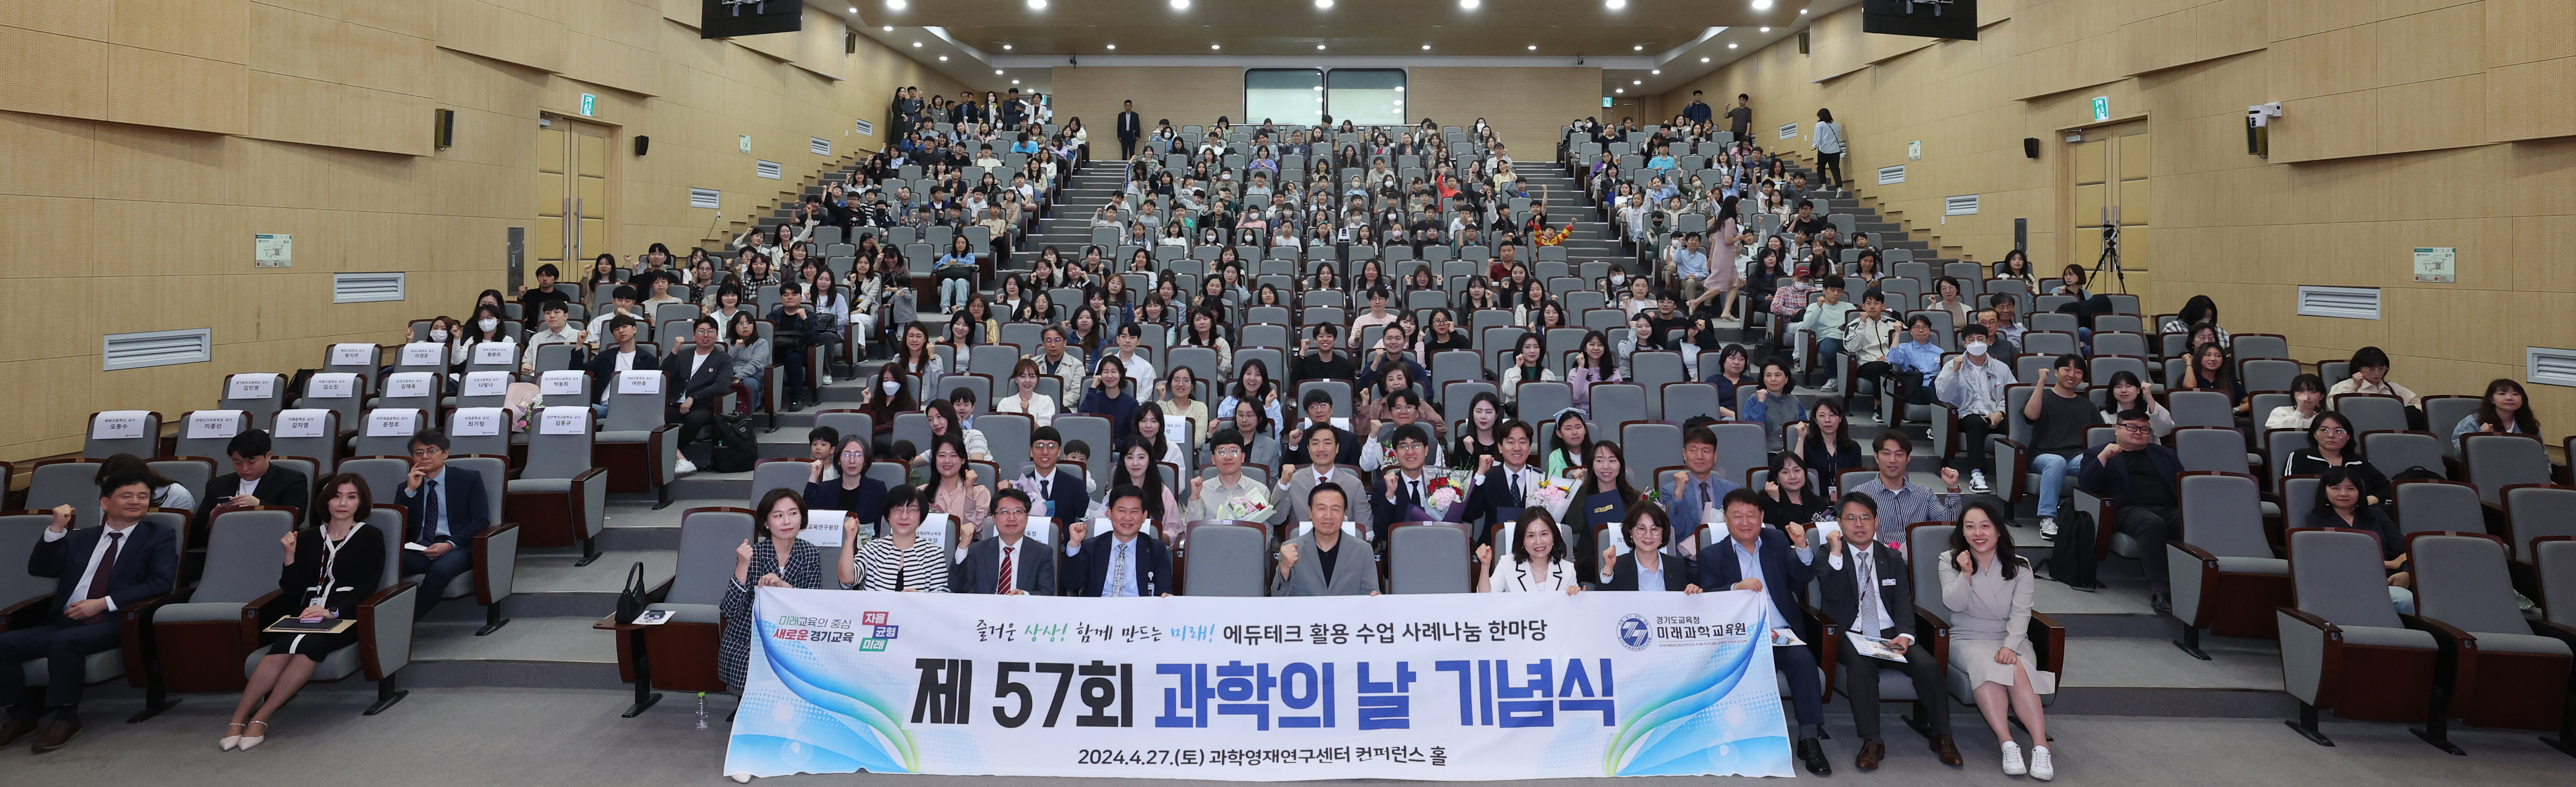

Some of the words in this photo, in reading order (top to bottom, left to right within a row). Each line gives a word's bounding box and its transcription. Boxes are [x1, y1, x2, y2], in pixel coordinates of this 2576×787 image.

[779, 616, 827, 627] 미래교육의
[831, 620, 851, 629] 중심
[865, 612, 886, 624] 자율
[773, 628, 808, 640] 새로운
[811, 631, 854, 642] 경기교육
[875, 626, 896, 637] 균형
[977, 620, 1016, 641] 즐거운
[1025, 623, 1067, 642] 상상!
[1076, 622, 1113, 643] 함께
[1122, 625, 1162, 643] 만드는
[1171, 624, 1215, 642] 미래!
[1224, 625, 1303, 645] 에듀테크
[1310, 623, 1349, 644] 활용
[1356, 622, 1394, 644] 수업
[1402, 622, 1482, 642] 사례나눔
[1488, 619, 1547, 641] 한마당
[1657, 622, 1746, 639] 미래과학교육원
[862, 640, 886, 650] 미래
[911, 658, 972, 724] 제
[993, 660, 1133, 728] 57회
[1155, 661, 1335, 731] 과학의
[1357, 662, 1416, 730] 날
[1436, 658, 1615, 728] 기념식
[1078, 749, 1204, 766] 2024.4.27.(토)
[1209, 746, 1350, 766] 과학영재연구센터
[1356, 746, 1425, 763] 컨퍼런스
[1430, 746, 1447, 766] 홀
